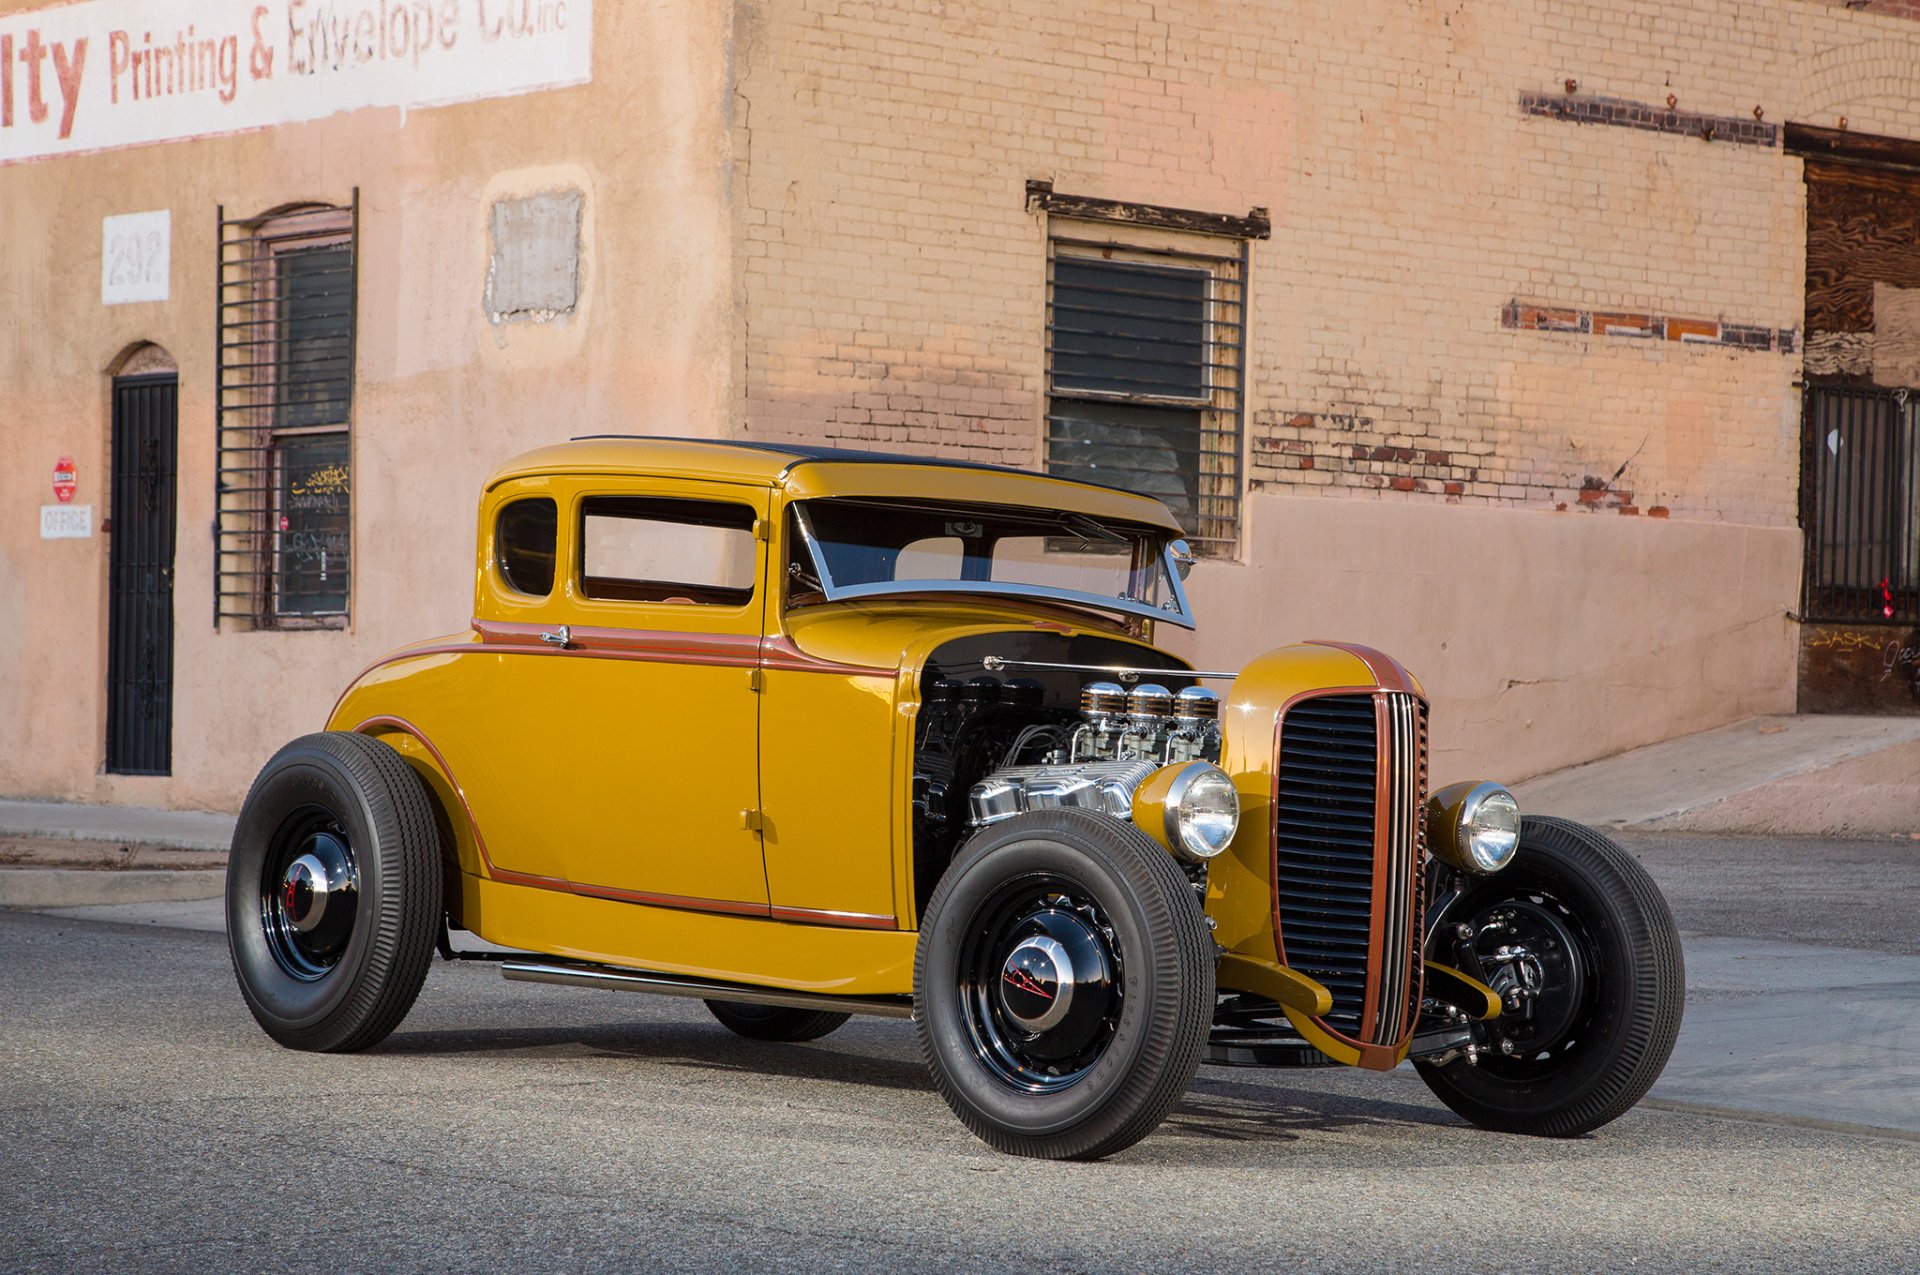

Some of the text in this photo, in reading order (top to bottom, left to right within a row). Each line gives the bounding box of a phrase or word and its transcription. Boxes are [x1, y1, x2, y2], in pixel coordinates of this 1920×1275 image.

[109, 24, 237, 104] Printing
[249, 5, 274, 80] &
[287, 0, 459, 75] Envelope
[108, 231, 162, 286] 292
[45, 511, 88, 531] OFFICE
